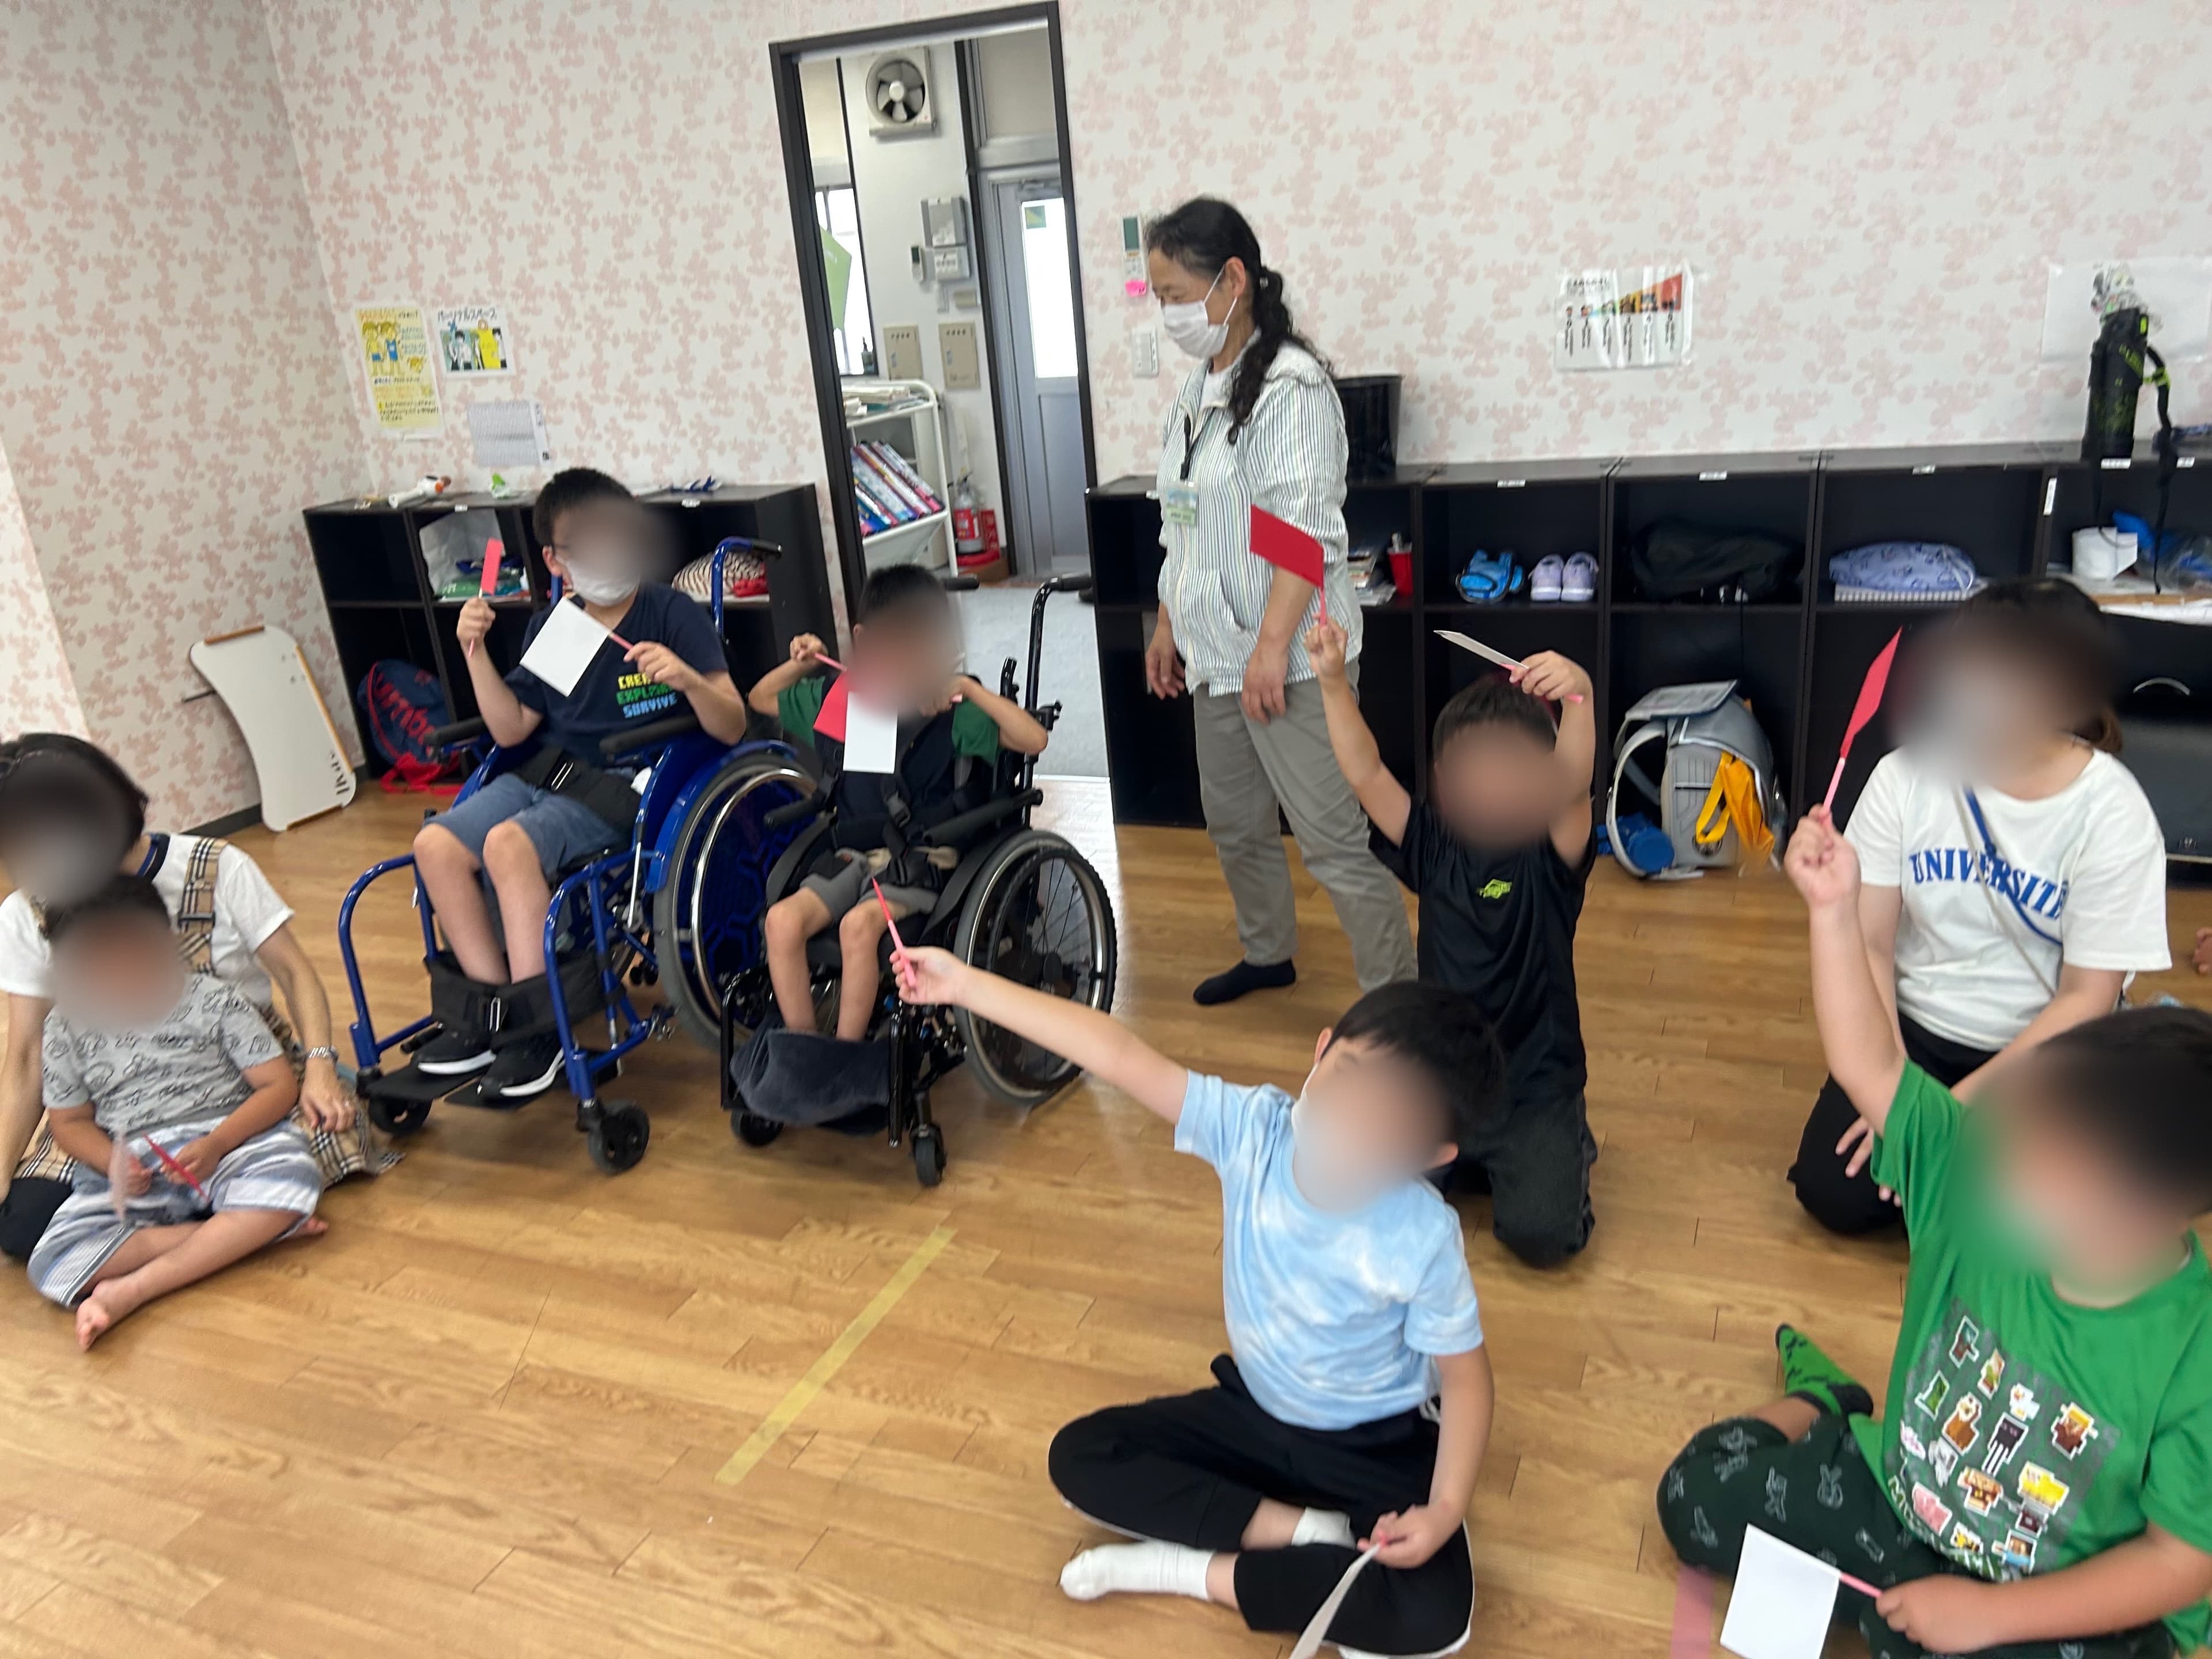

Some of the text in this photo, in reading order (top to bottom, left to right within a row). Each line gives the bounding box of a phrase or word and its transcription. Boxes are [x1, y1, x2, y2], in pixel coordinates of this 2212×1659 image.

[618, 672, 651, 690] CREA
[375, 672, 435, 757] umbr
[623, 692, 677, 718] SURVIVE
